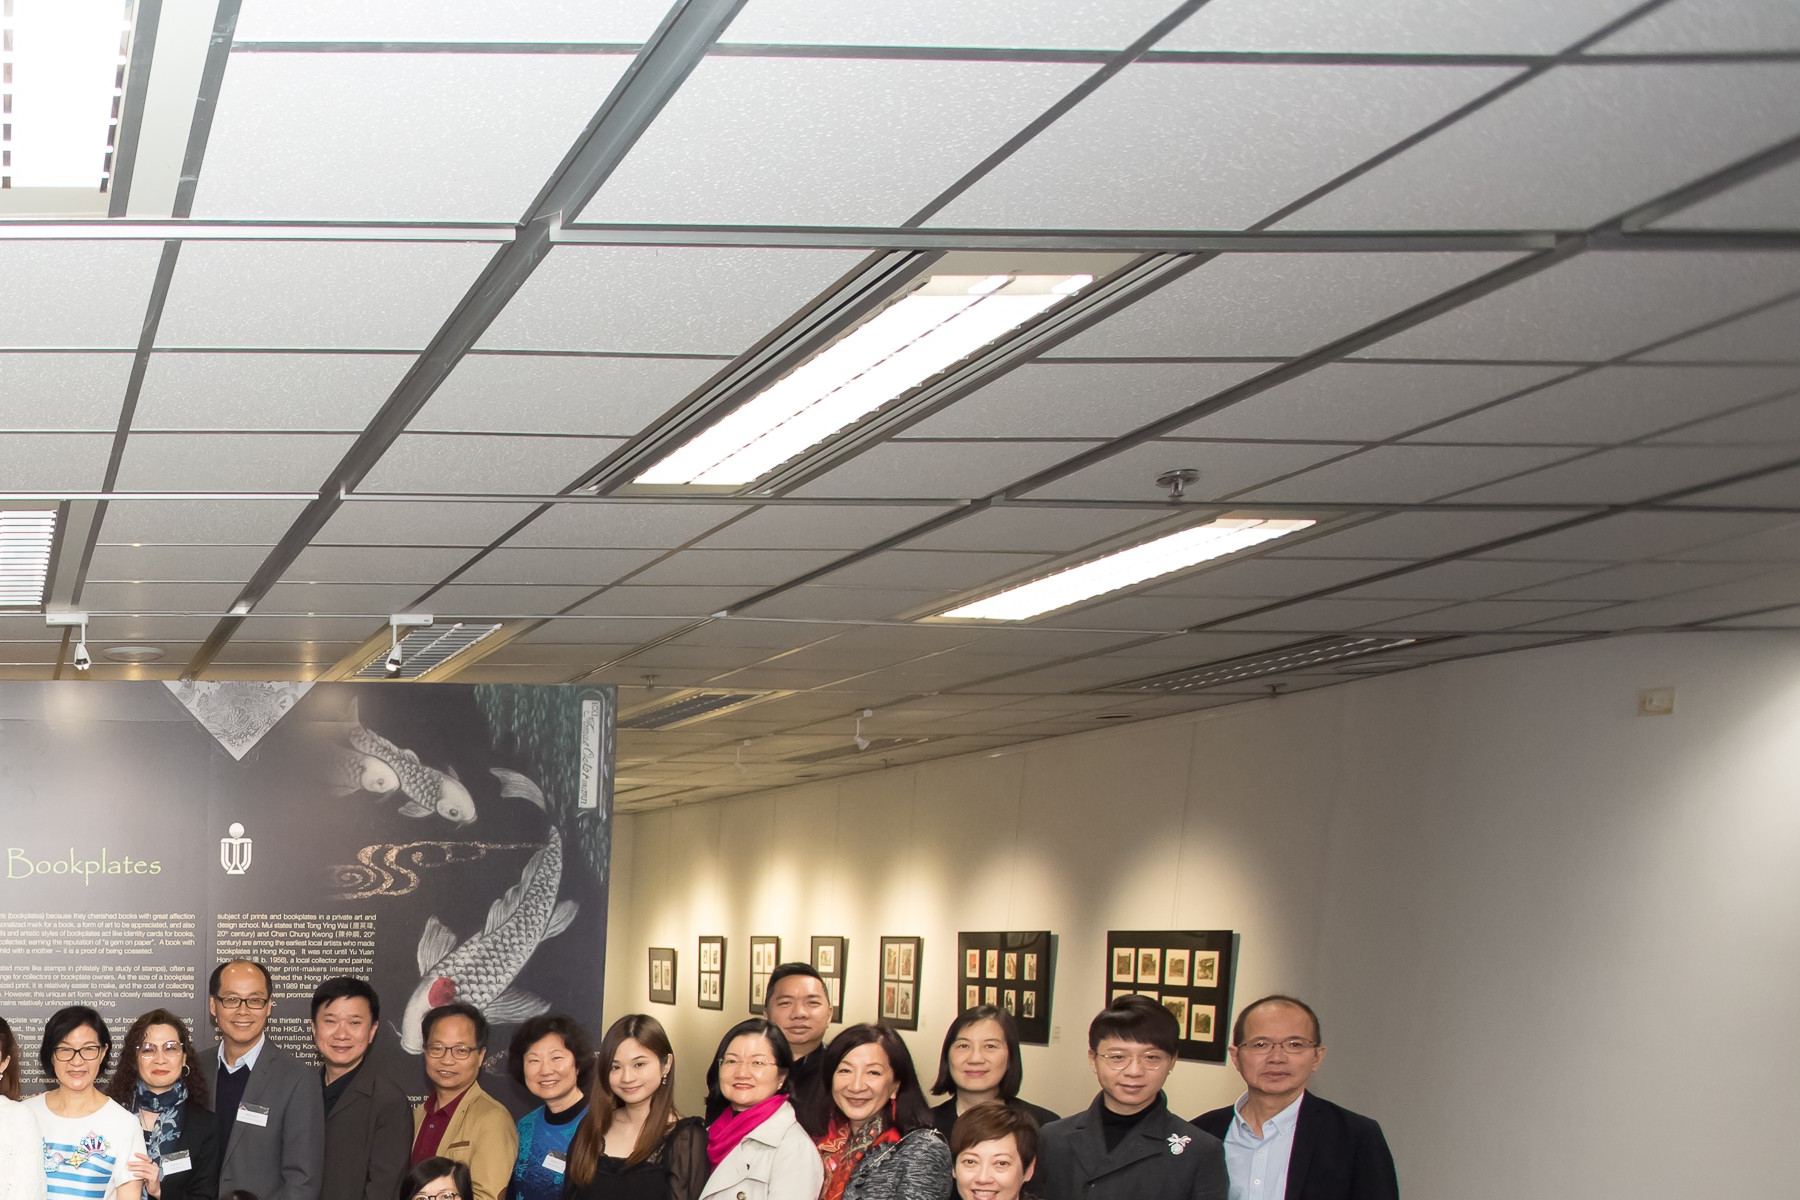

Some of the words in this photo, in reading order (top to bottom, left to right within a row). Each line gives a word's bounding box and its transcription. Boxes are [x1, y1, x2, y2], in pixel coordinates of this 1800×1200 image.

[6, 847, 162, 887] Bookplates
[72, 912, 86, 921] they
[151, 912, 168, 921] great
[217, 912, 240, 921] subject
[249, 912, 268, 921] prints
[268, 912, 281, 920] and
[282, 913, 317, 922] bookplates
[331, 913, 353, 922] private
[353, 913, 363, 921] art
[364, 913, 376, 921] and
[217, 921, 237, 930] design
[261, 921, 273, 929] Mui
[273, 921, 292, 929] states
[293, 921, 305, 929] that
[306, 921, 321, 930] Tong
[322, 921, 336, 930] Ying
[337, 921, 348, 929] Wai
[270, 930, 287, 938] Chan
[289, 930, 310, 939] Chung
[311, 930, 334, 939] Kwong
[252, 940, 274, 948] among
[342, 939, 356, 947] who
[356, 939, 374, 947] made
[217, 947, 250, 956] bookplates
[259, 947, 277, 956] Hong
[321, 947, 332, 955] not
[31, 964, 42, 972] like
[43, 964, 66, 973] stamps
[74, 964, 100, 973] philately
[114, 964, 132, 974] study
[33, 990, 45, 998] this
[45, 990, 66, 999] unique
[67, 990, 76, 998] art
[93, 990, 112, 998] which
[119, 990, 141, 999] closely
[141, 990, 163, 998] related
[170, 990, 194, 999] reading
[17, 999, 44, 1008] relatively
[44, 999, 72, 1007] unknown
[80, 999, 98, 1008] Hong
